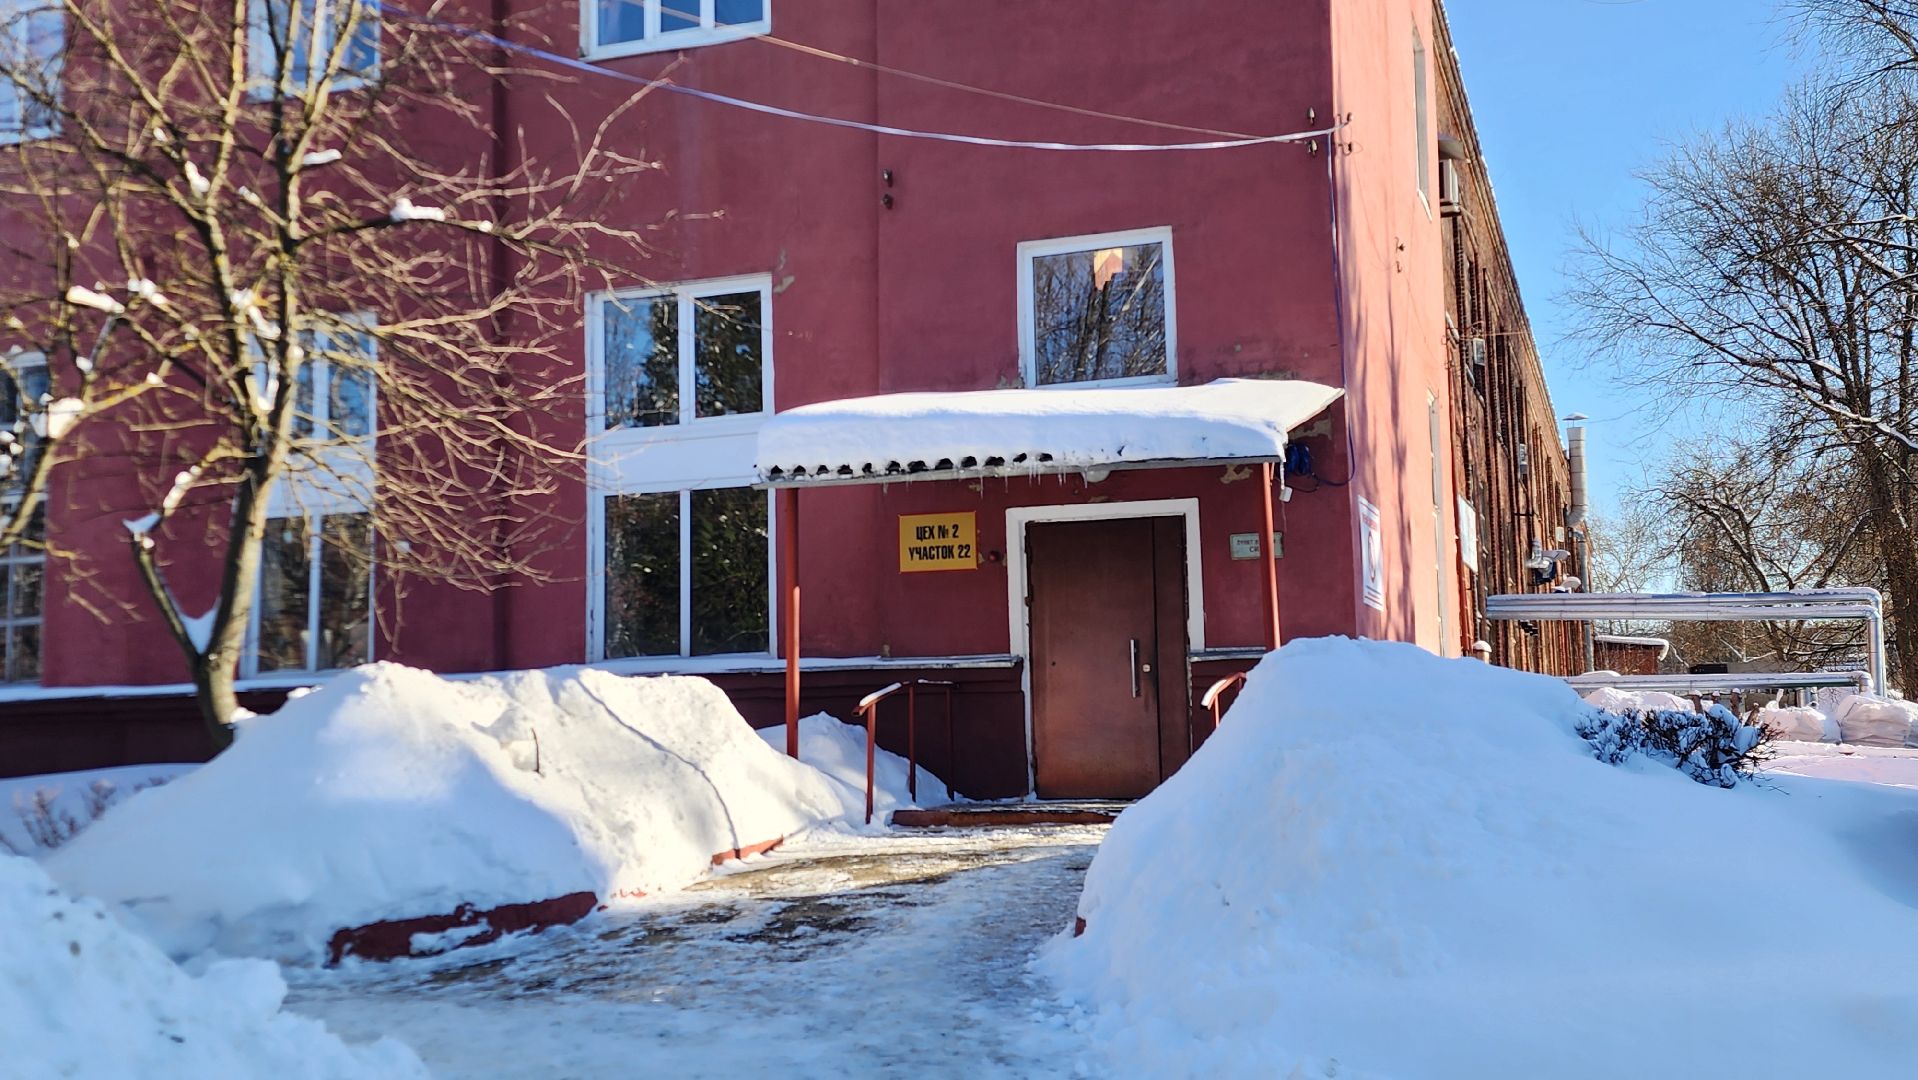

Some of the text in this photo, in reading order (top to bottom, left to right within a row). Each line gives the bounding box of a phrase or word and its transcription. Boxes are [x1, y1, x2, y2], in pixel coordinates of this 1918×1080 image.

[916, 524, 959, 542] ЦЕХ № 2
[909, 544, 971, 561] УЧАСТОК 22
